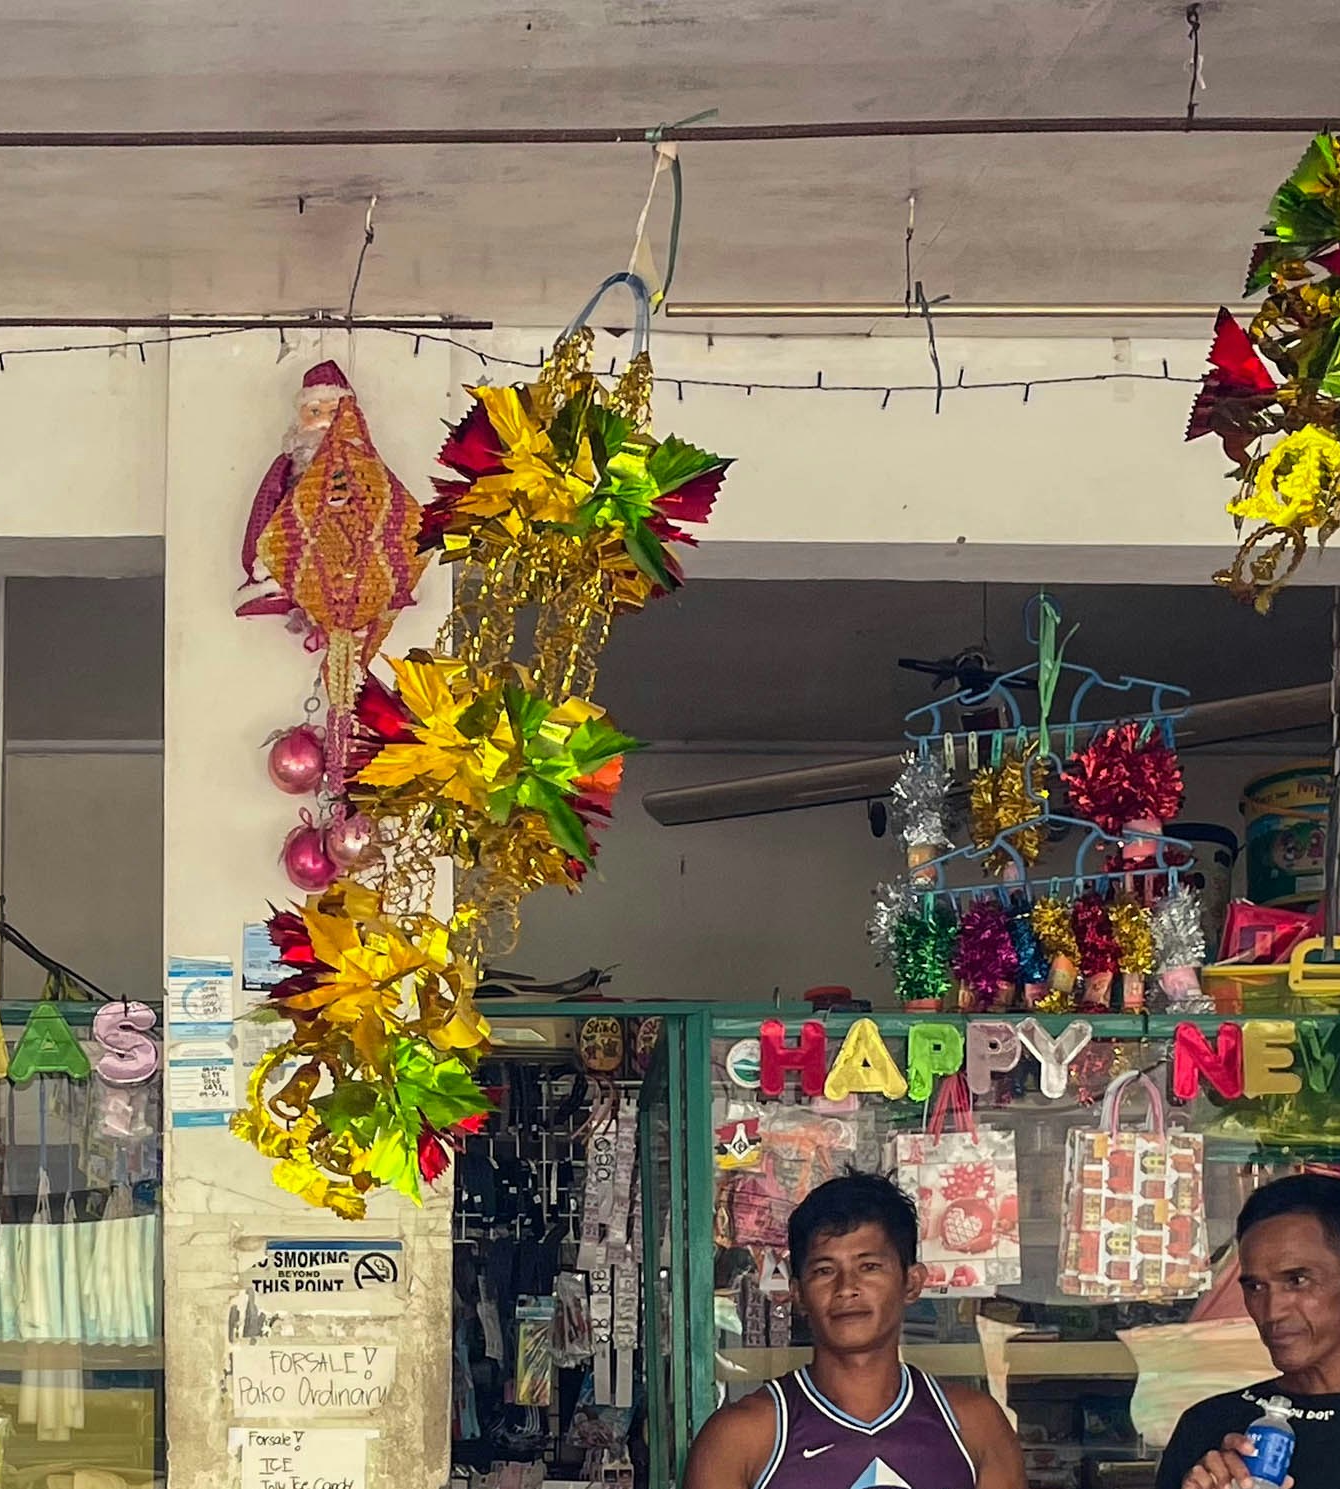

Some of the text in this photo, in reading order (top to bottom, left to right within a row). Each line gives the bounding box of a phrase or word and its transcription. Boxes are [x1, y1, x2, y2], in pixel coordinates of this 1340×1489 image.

[760, 1017, 1092, 1102] HAPPY
[278, 1270, 320, 1278] BEYOND
[252, 1280, 344, 1293] THIS POINT
[238, 1377, 389, 1407] Pako Ordinary
[259, 1457, 294, 1475] ICE
